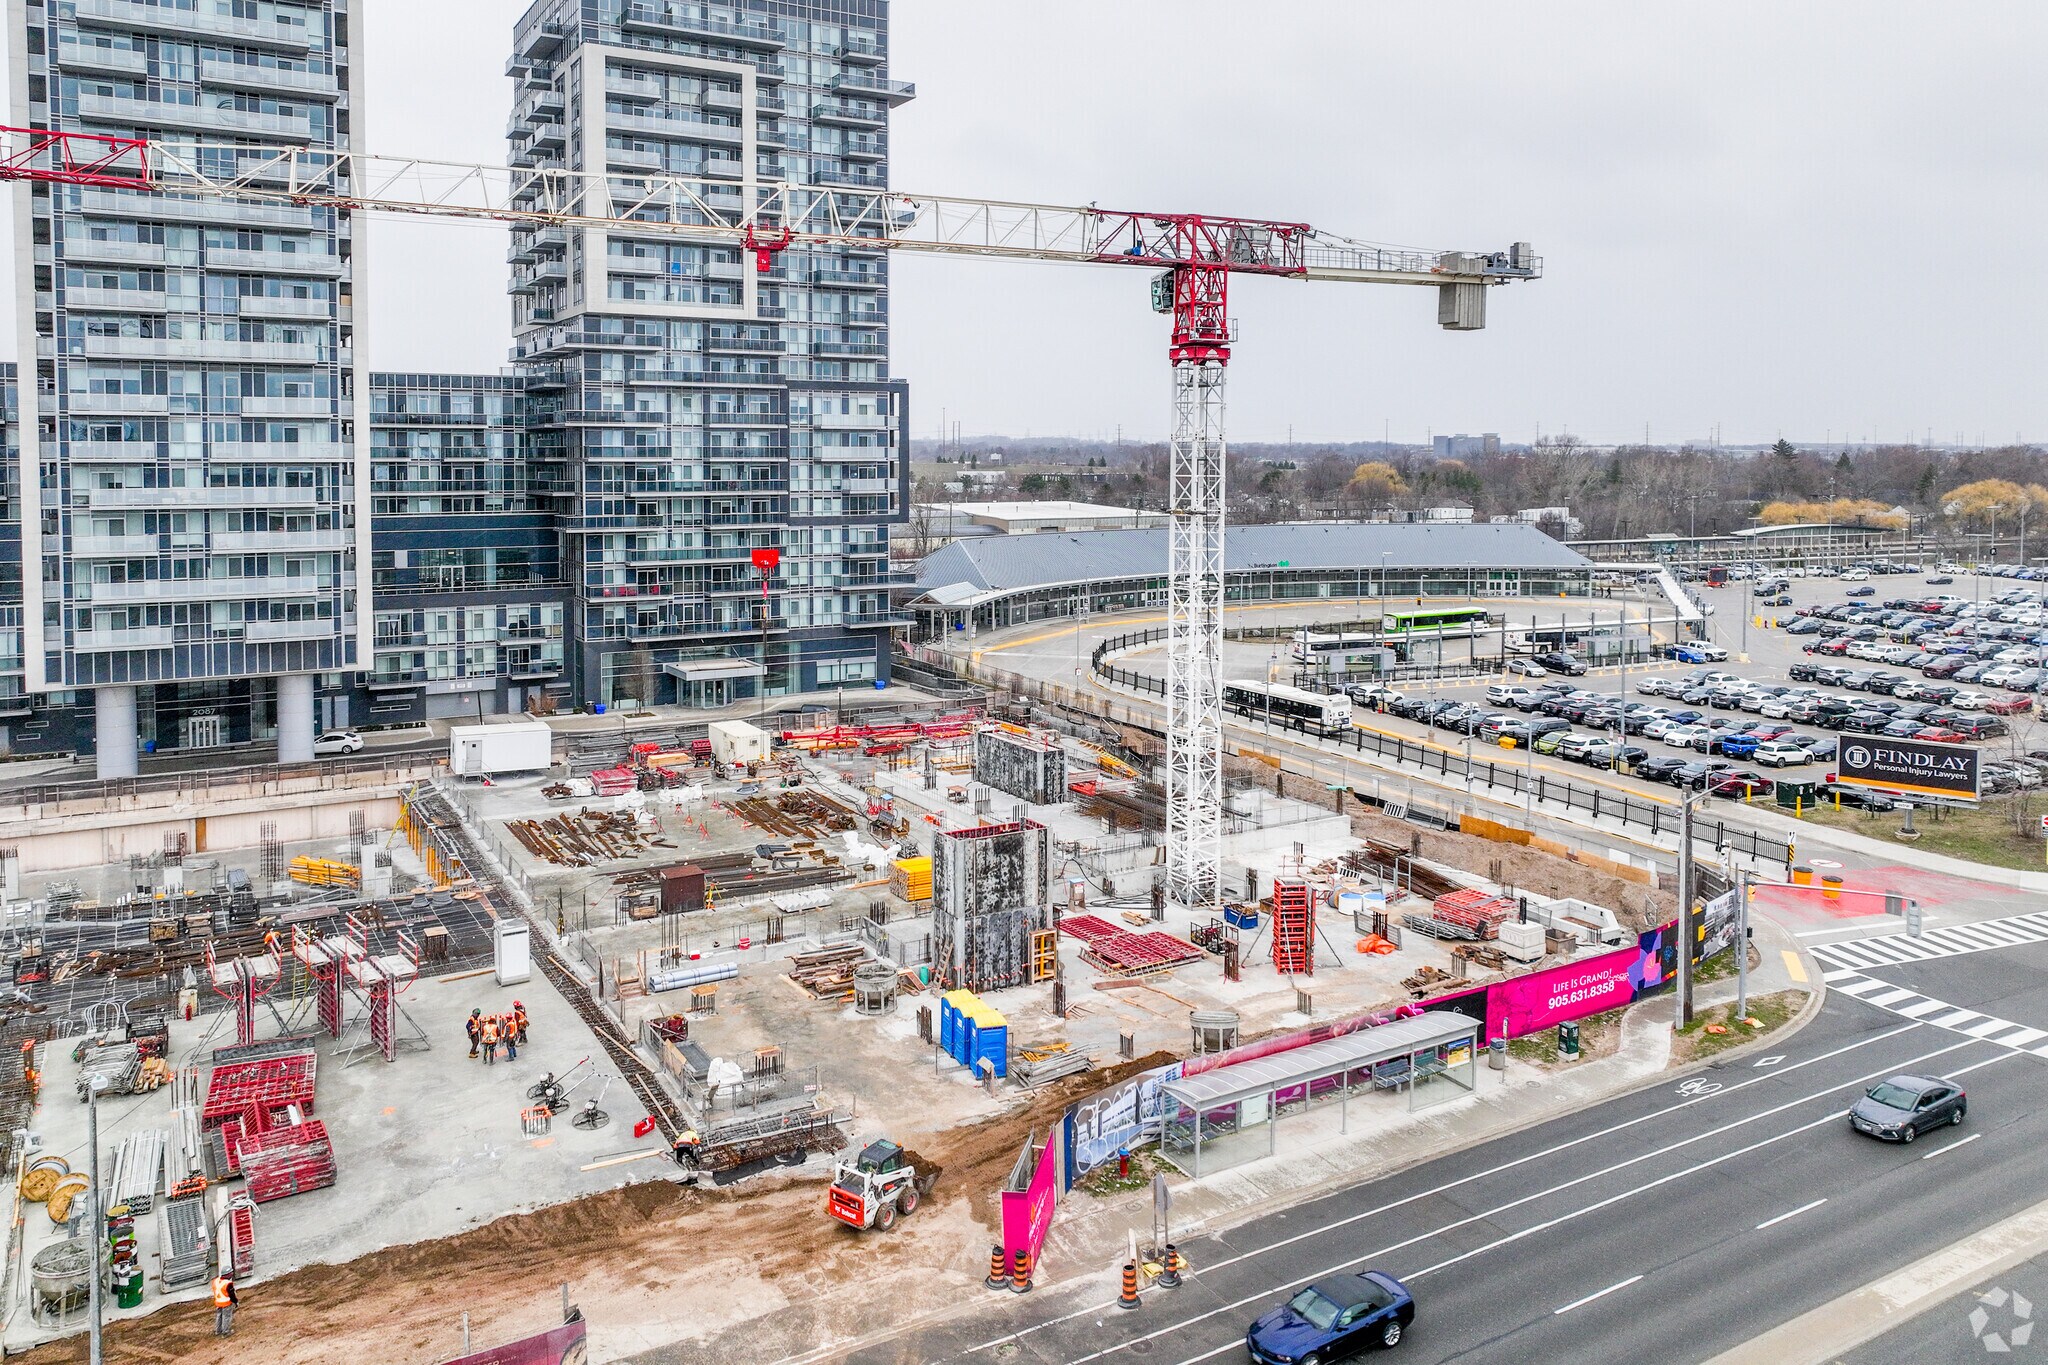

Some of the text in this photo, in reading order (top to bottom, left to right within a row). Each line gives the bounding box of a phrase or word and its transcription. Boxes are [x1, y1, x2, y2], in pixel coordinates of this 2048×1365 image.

[192, 707, 216, 716] 2087
[1874, 748, 1971, 771] FINDLAY
[1873, 762, 1968, 780] Personal Injury Lawyers
[1548, 980, 1615, 1010] 905.631.8358
[841, 1207, 857, 1220] Bobcat
